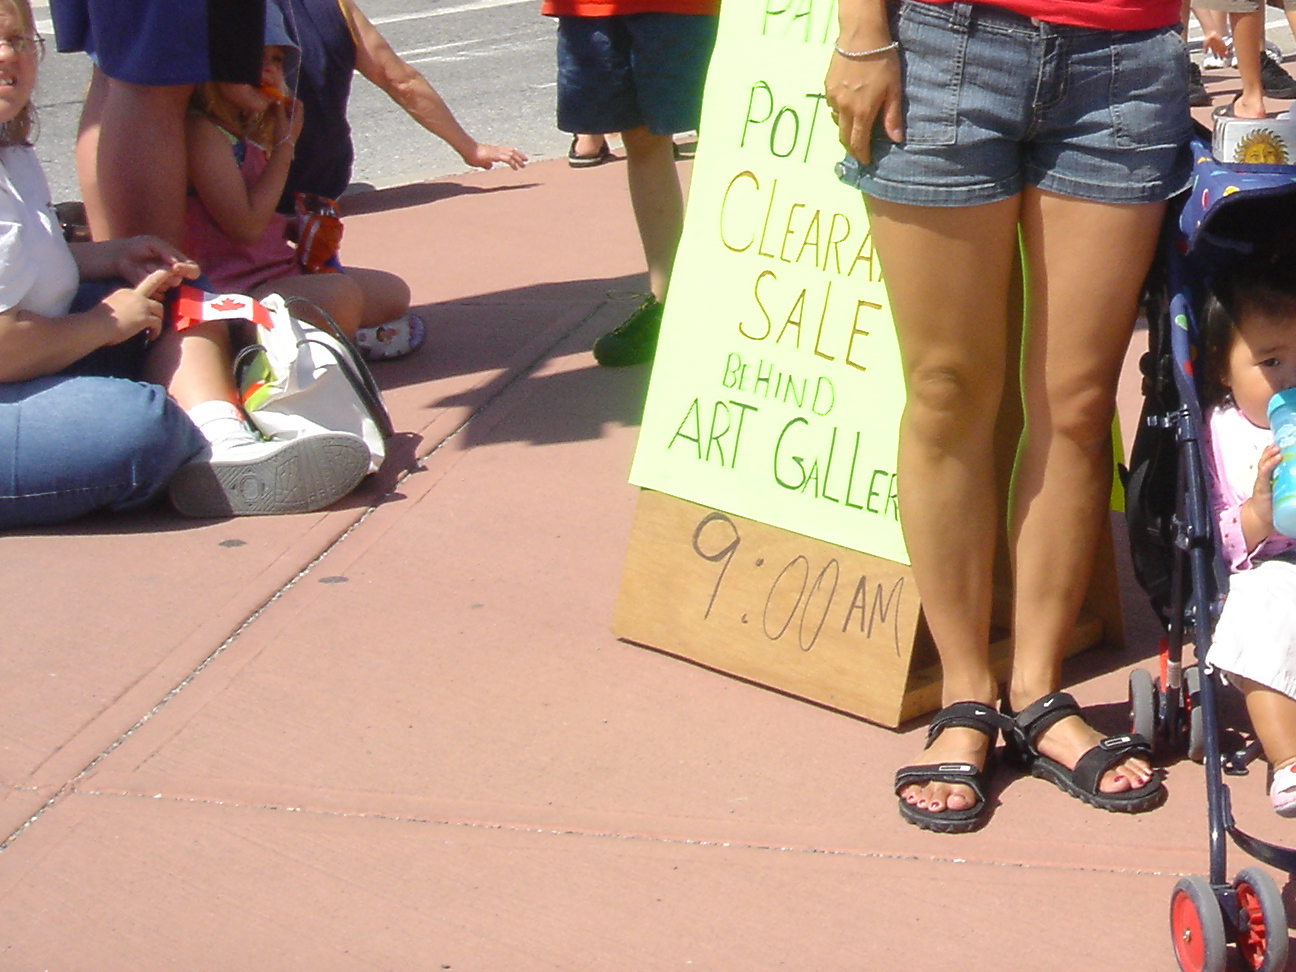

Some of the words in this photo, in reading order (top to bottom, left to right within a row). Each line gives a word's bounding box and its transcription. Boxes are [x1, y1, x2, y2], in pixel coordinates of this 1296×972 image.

[740, 79, 827, 163] POT
[719, 169, 884, 283] CLEARA
[738, 269, 883, 372] SALE
[721, 352, 835, 417] BEHIND
[667, 397, 759, 469] ART
[773, 416, 899, 522] GALLER
